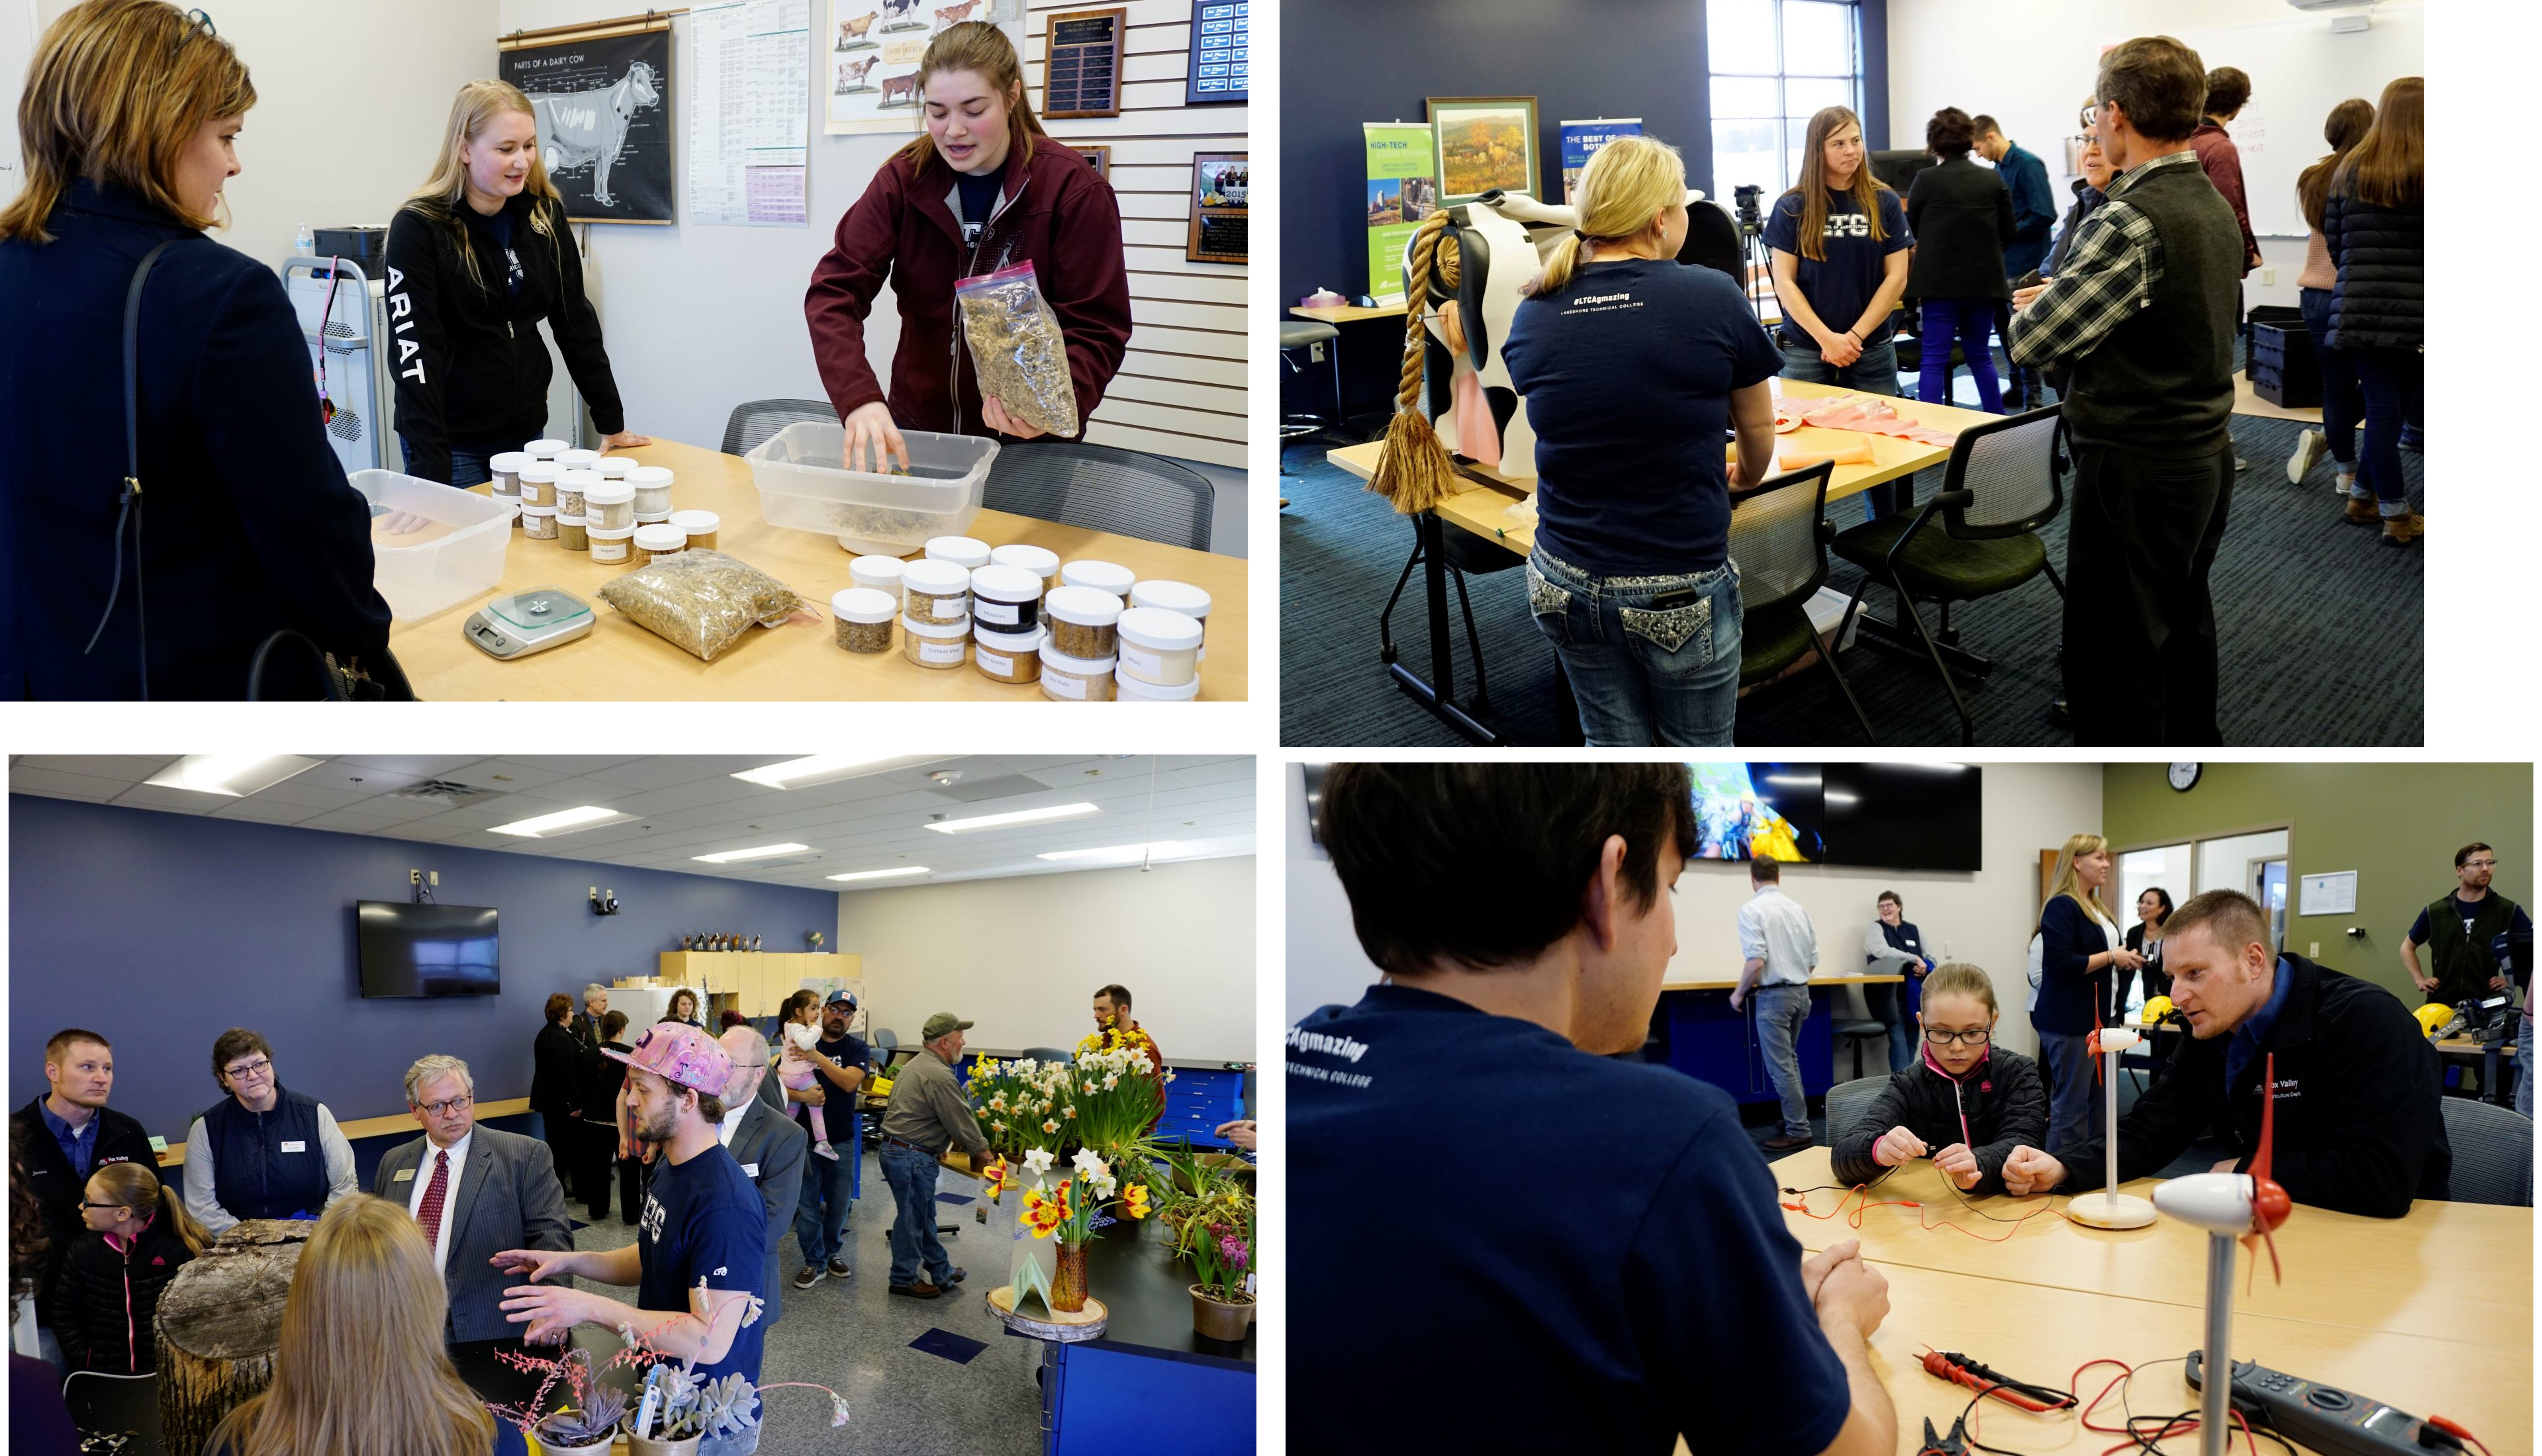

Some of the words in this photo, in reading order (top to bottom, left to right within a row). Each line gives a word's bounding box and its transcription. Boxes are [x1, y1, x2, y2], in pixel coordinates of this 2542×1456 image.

[902, 45, 923, 54] BREEDS
[514, 61, 531, 69] PARTS
[549, 56, 568, 66] DAIRY
[569, 54, 585, 64] COW
[1574, 293, 1630, 306] #LTCAgmazing
[387, 265, 426, 384] ARIAT
[984, 610, 1006, 619] Molasses
[990, 657, 1006, 667] Grains
[1128, 655, 1141, 667] Whey
[1330, 1070, 1374, 1089] COLLEGE
[2280, 1079, 2298, 1090] Valley
[640, 1192, 667, 1245] LTC
